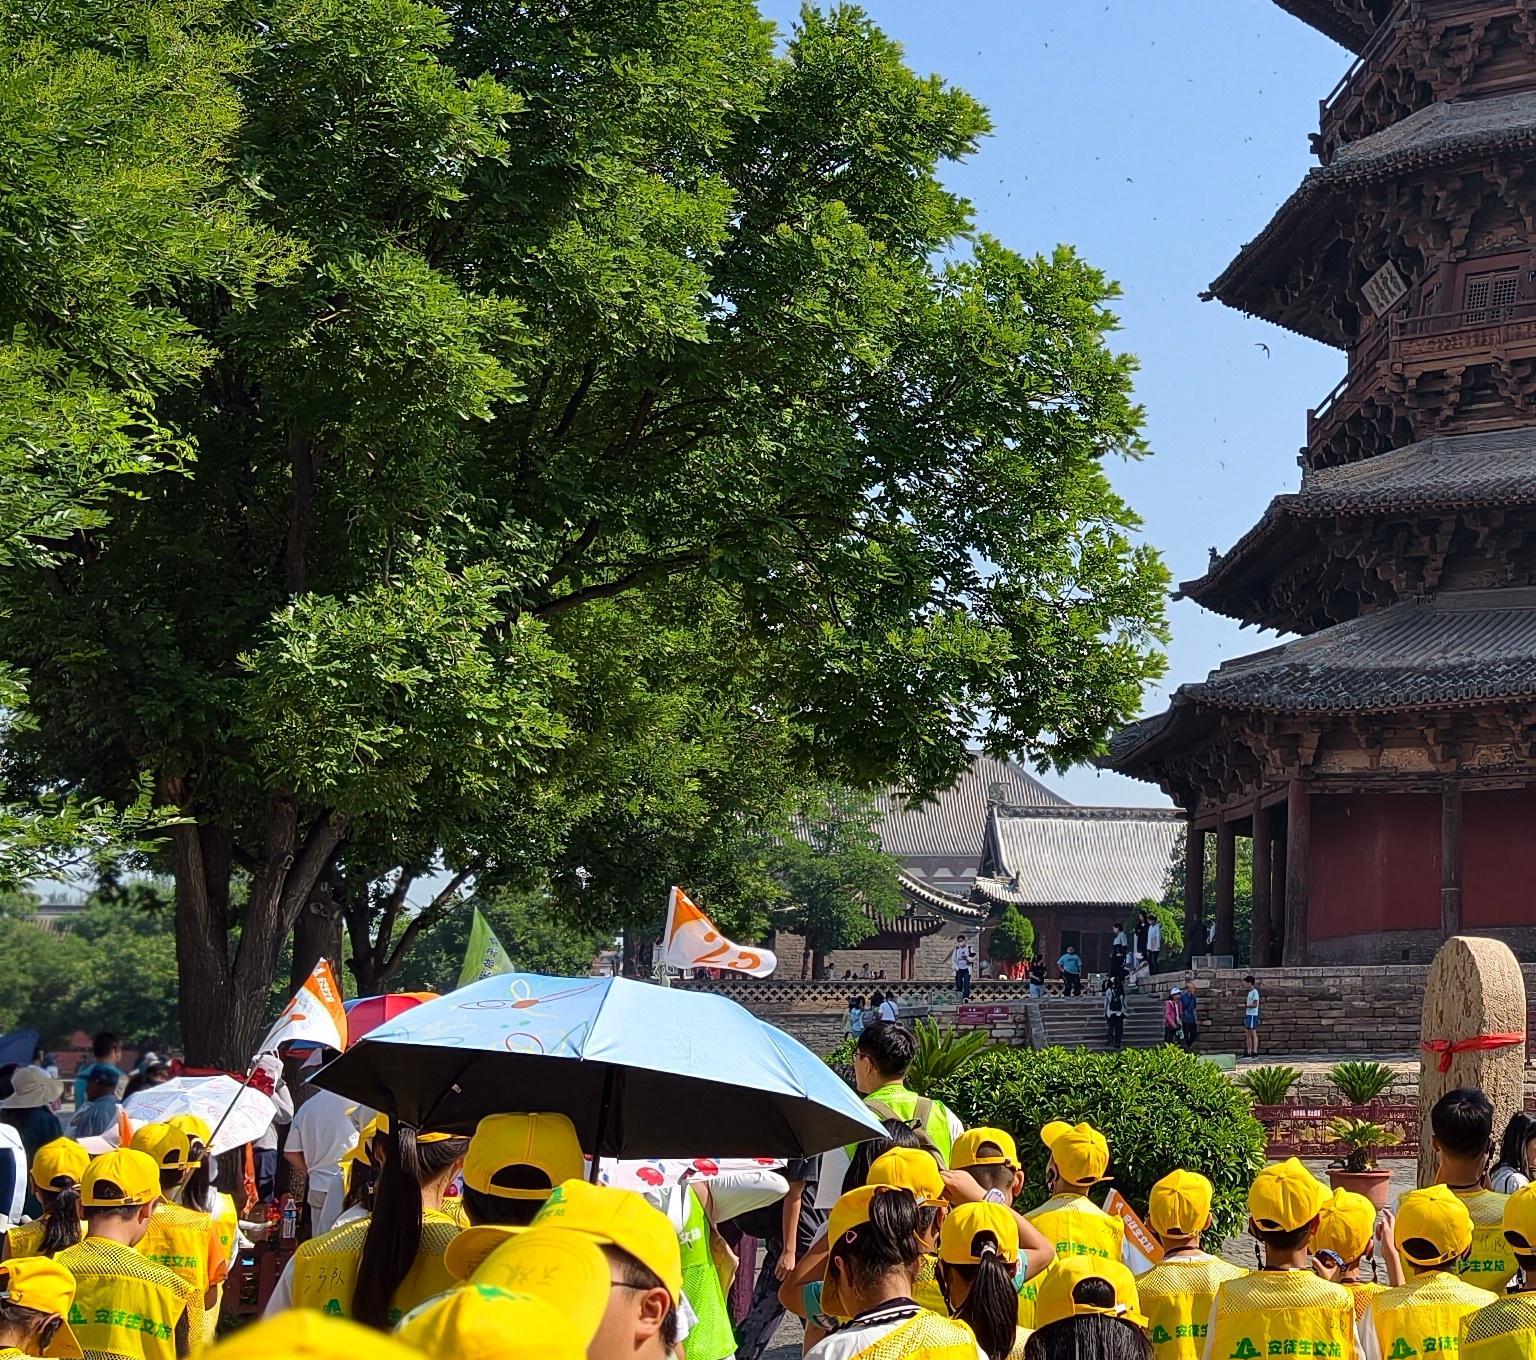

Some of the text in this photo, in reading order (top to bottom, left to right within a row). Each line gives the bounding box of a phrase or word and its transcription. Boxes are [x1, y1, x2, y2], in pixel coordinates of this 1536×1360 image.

[1267, 1339, 1341, 1358] 安徒生文旅
